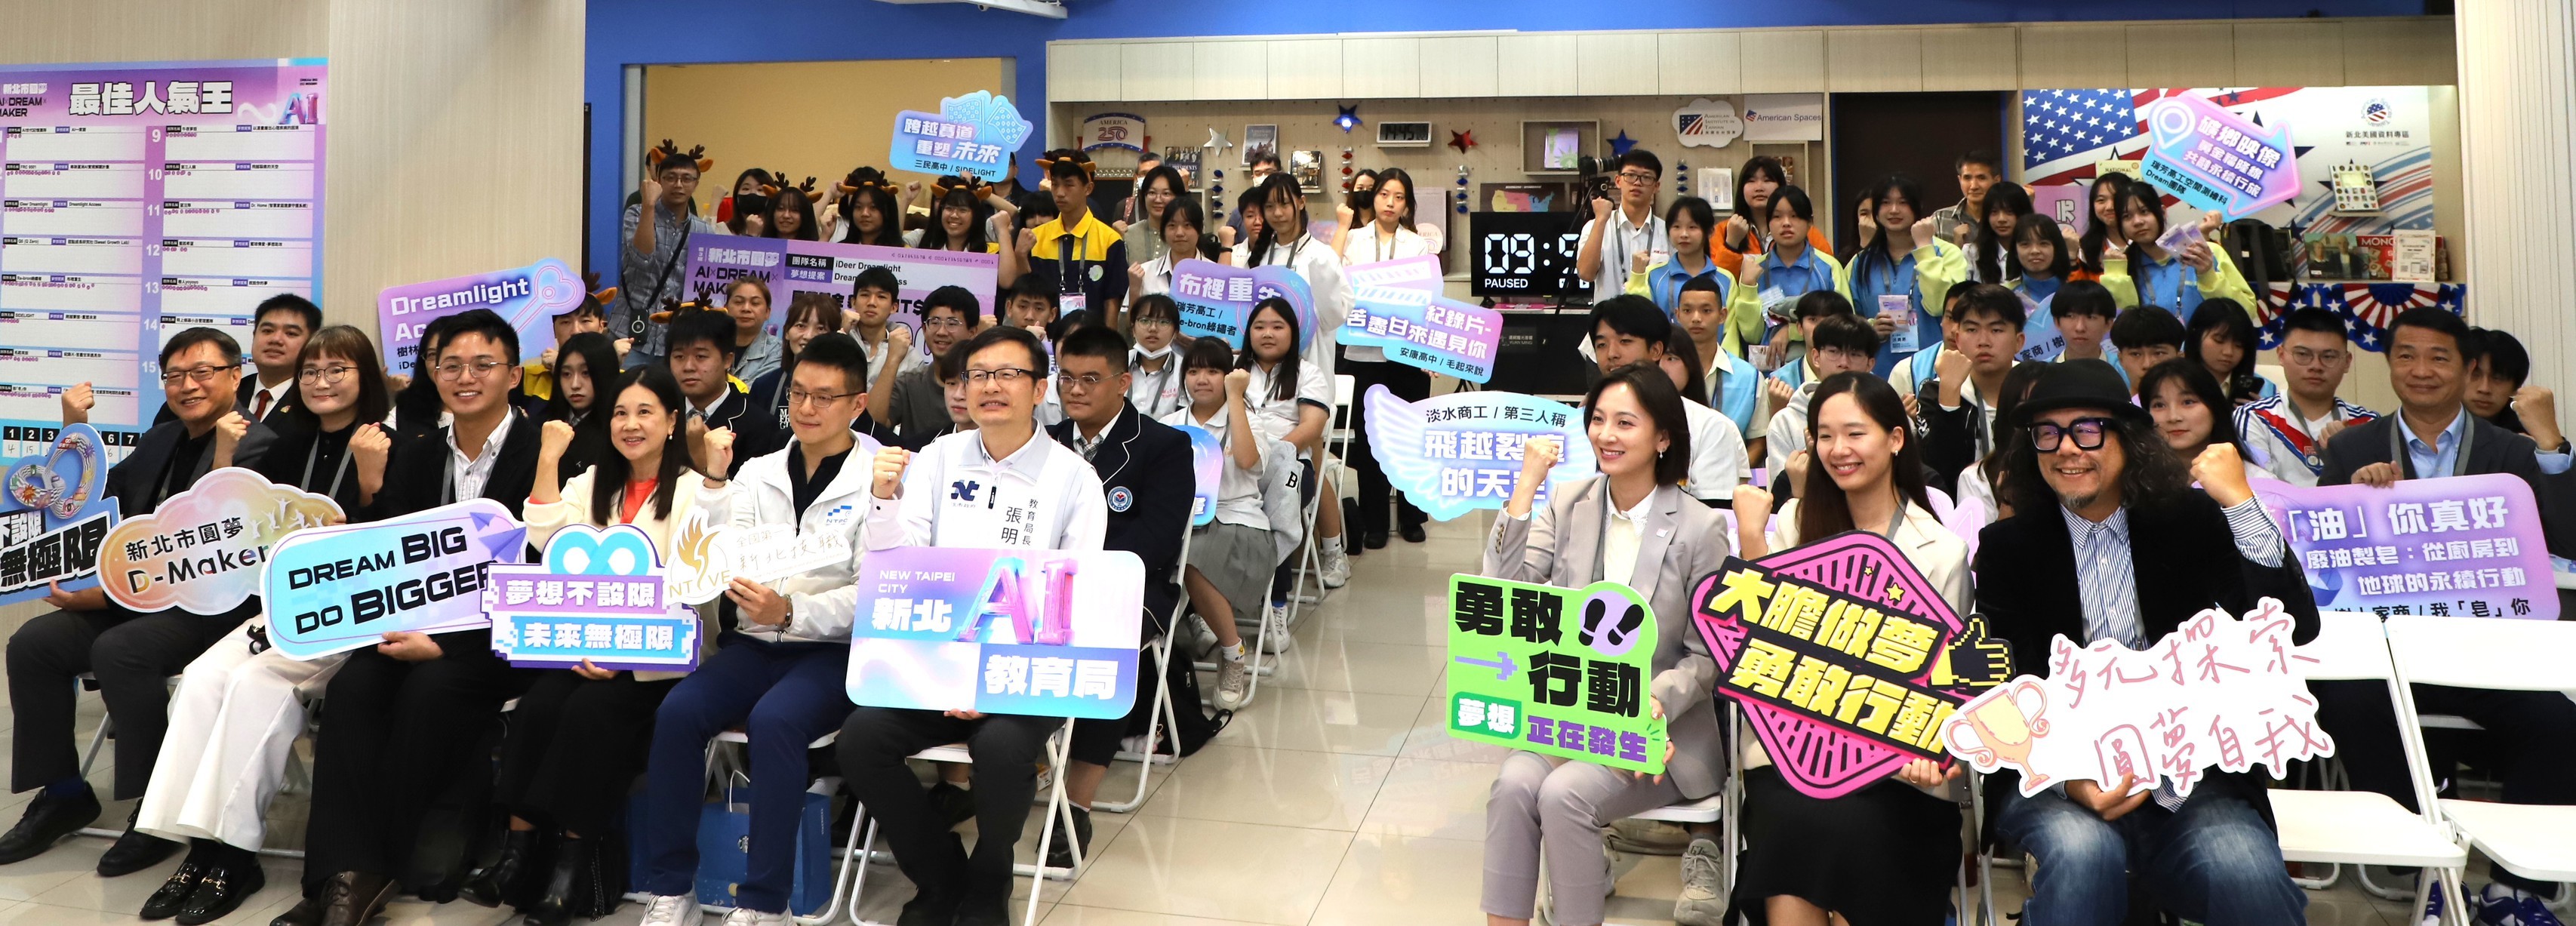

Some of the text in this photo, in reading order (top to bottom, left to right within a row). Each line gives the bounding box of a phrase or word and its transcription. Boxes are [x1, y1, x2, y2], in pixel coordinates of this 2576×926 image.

[69, 81, 232, 115] 最佳人氣王
[278, 93, 319, 125] AI
[152, 129, 161, 142] 9
[904, 118, 973, 140] 跨越賽道
[1098, 126, 1128, 141] 250
[2197, 115, 2282, 171] 礦鄉映像
[916, 140, 1002, 163] 重塑 未來
[149, 169, 162, 180] 10
[915, 160, 947, 171] 三民高中
[956, 166, 996, 177] SIDELIGHT
[2146, 169, 2187, 195] Dream團隊
[2183, 150, 2263, 199] 共融永續行旅
[2150, 160, 2228, 206] 瑞芳高工空間測繪科
[147, 205, 160, 216] 11
[146, 245, 159, 256] 12
[709, 248, 779, 267] 新北市圓夢
[792, 257, 826, 267] 團隊名稱
[791, 269, 825, 280] 夢想提案
[858, 263, 901, 272] Dreamlight
[145, 282, 158, 294] 13
[391, 278, 528, 315] Dreamlight
[1485, 279, 1528, 288] PAUSED
[1177, 302, 1215, 318] 瑞芳高工
[144, 319, 157, 331] 14
[1180, 318, 1237, 337] e-bron綠繡者
[1346, 309, 1488, 359] 苦盡甘來遇見你
[143, 361, 156, 373] 15
[399, 361, 415, 371] iDe
[1400, 347, 1437, 364] 安康高中
[1446, 359, 1484, 377] 毛起來說
[1426, 406, 1488, 423] 淡水商工
[1504, 406, 1567, 428] 第三人稱
[9, 429, 134, 443] 1 2 3 6 7
[1002, 506, 1022, 544] 張明
[1023, 499, 1038, 546] 教育局長
[2288, 496, 2509, 542] 「油」你真好
[0, 515, 107, 587] 無極限
[125, 518, 243, 561] 新北市圓夢
[128, 545, 269, 593] D-Maker
[288, 527, 467, 589] DREAM BIG
[878, 583, 908, 594] CITY
[880, 570, 955, 582] NEW TAIPEI
[2358, 568, 2525, 596] 地球的永續行動
[506, 580, 655, 608] 夢想不設限
[872, 557, 1078, 645] 新北 AI
[2430, 598, 2531, 617] 我「皂」你
[295, 605, 343, 635] DO
[1454, 581, 1563, 647] 勇敢
[1708, 568, 1939, 673] 大膽做夢
[524, 623, 674, 651] 未來無極限
[2054, 603, 2320, 709] 多元探索
[985, 654, 1119, 700] 教育局
[1528, 650, 1641, 718] 行動
[1728, 638, 1959, 754] 勇敢行動
[1457, 697, 1647, 763] 夢想 正在發生
[2094, 694, 2328, 791] 圓夢自我
